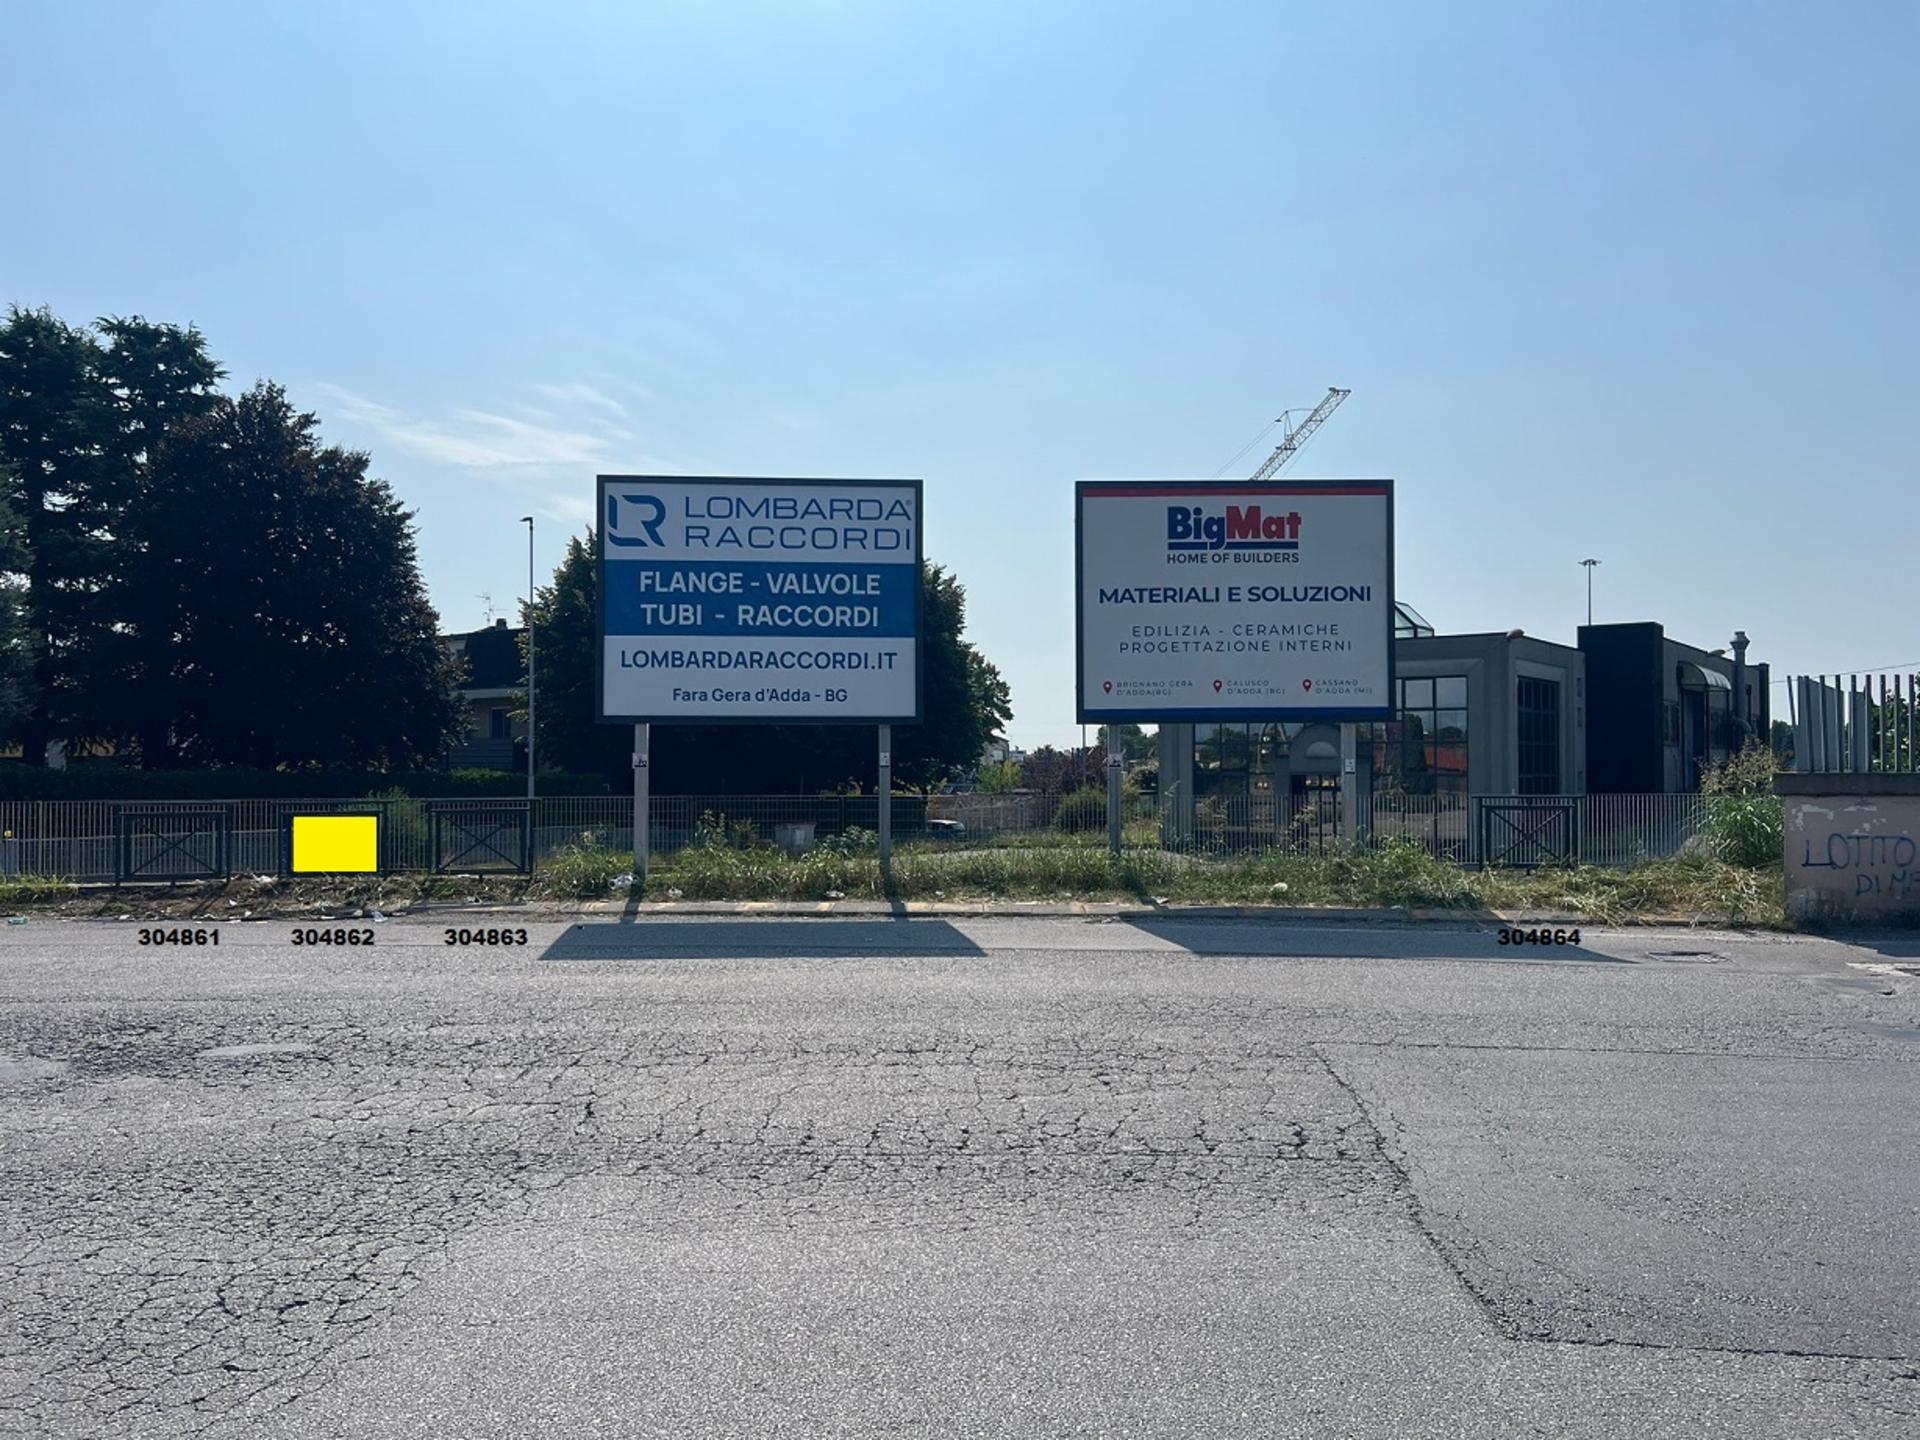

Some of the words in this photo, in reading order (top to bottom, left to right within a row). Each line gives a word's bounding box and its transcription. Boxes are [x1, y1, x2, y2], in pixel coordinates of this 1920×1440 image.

[685, 495, 912, 521] LOMBARDA
[1167, 505, 1302, 550] BigMat
[685, 525, 911, 551] RACCORDI
[1167, 553, 1208, 564] HOME
[1212, 553, 1230, 564] OF
[1233, 552, 1299, 564] BUILDERS
[639, 571, 743, 594] FLANGE
[766, 572, 881, 596] VALVOLE
[1099, 587, 1220, 604] MATERIALI
[1228, 586, 1241, 602] E
[1247, 585, 1371, 603] SOLUZIONI
[640, 604, 702, 626] TUBI
[738, 604, 879, 628] RACCORDI
[1132, 625, 1210, 637] EDILIZIA
[1232, 624, 1339, 637] CERAMICHE
[1119, 640, 1271, 654] PROGETTAZIONE
[1280, 639, 1352, 652] INTERNI
[621, 649, 898, 671] LOMBARDARACCORDI.IT
[1315, 679, 1359, 687] CASSANO
[672, 688, 708, 702] Fara
[711, 688, 751, 702] Gera
[755, 688, 810, 702] d'Adda
[825, 688, 848, 702] BG
